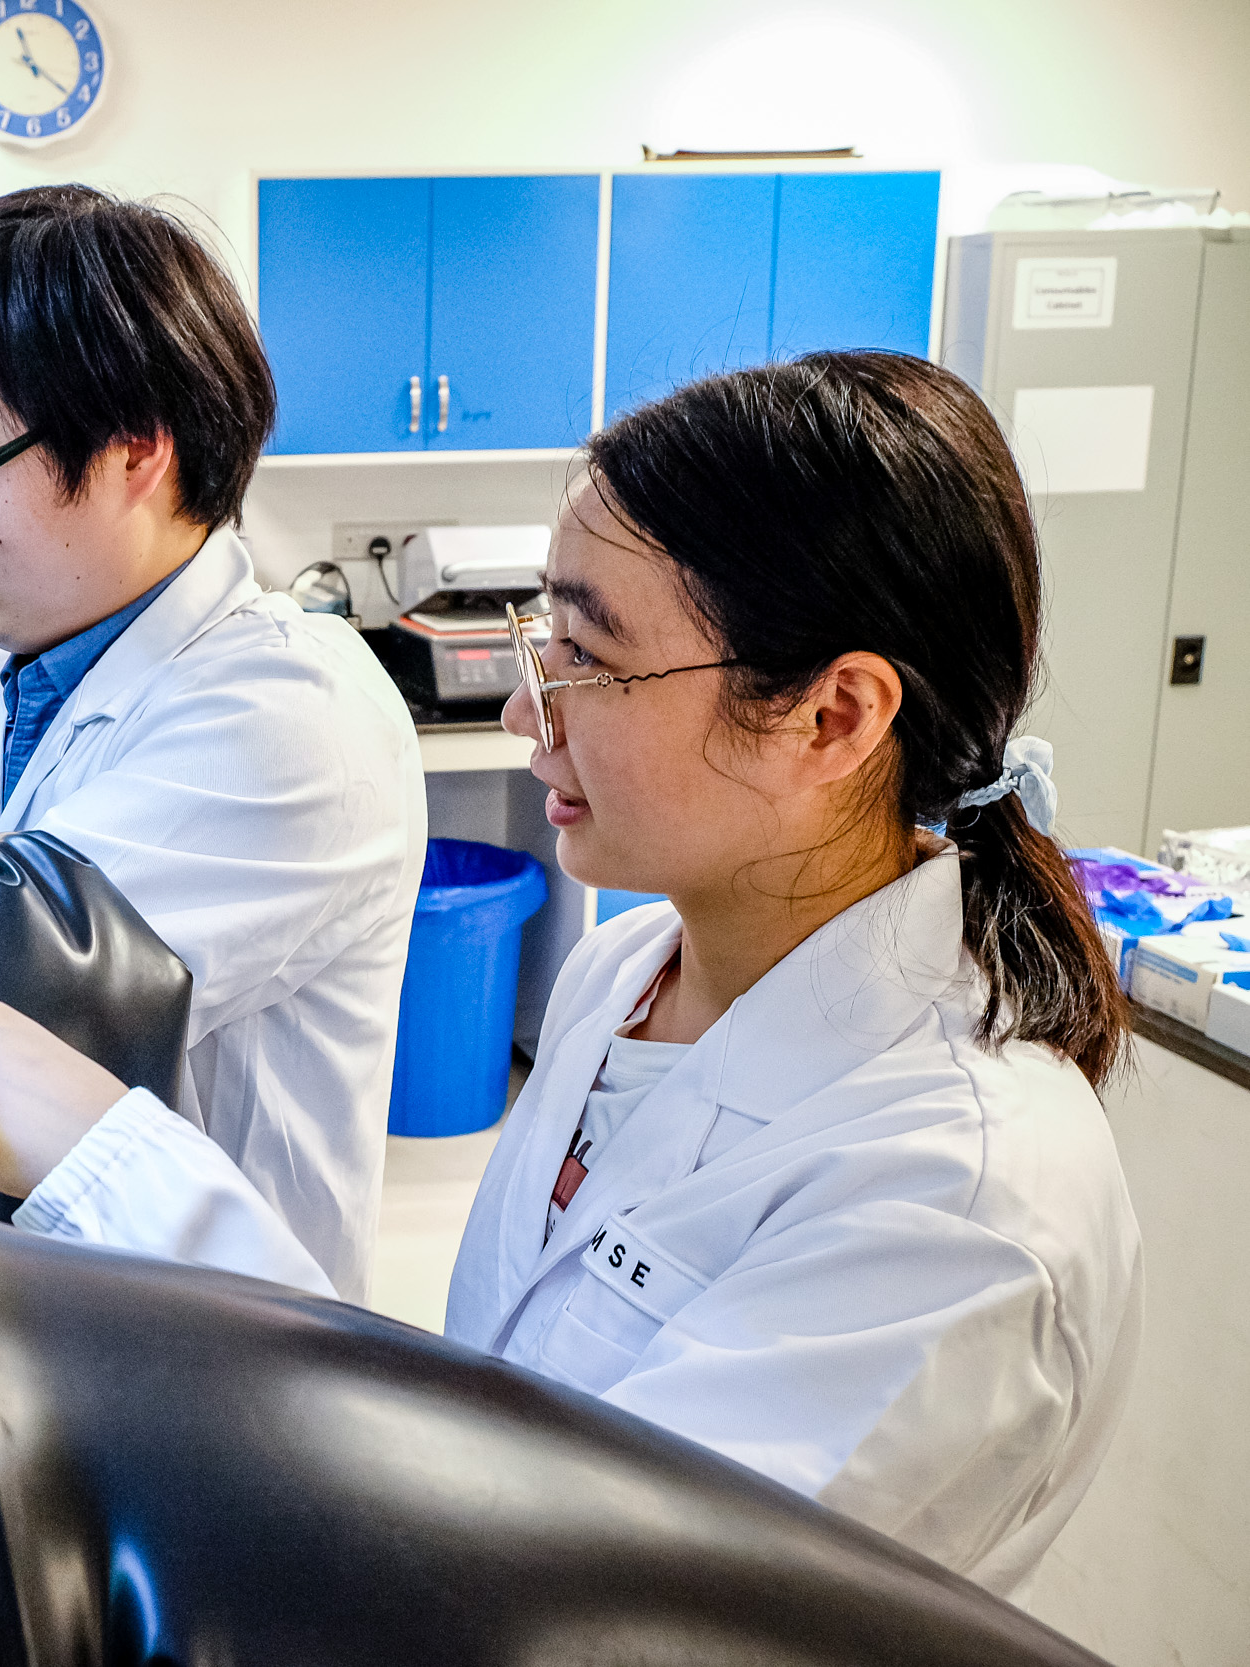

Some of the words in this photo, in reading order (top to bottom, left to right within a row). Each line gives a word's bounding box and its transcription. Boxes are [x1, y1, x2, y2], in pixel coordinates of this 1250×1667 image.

[75, 19, 90, 41] 2
[84, 51, 99, 73] 3
[77, 84, 91, 103] 4
[26, 117, 42, 137] 6
[56, 107, 71, 128] 5
